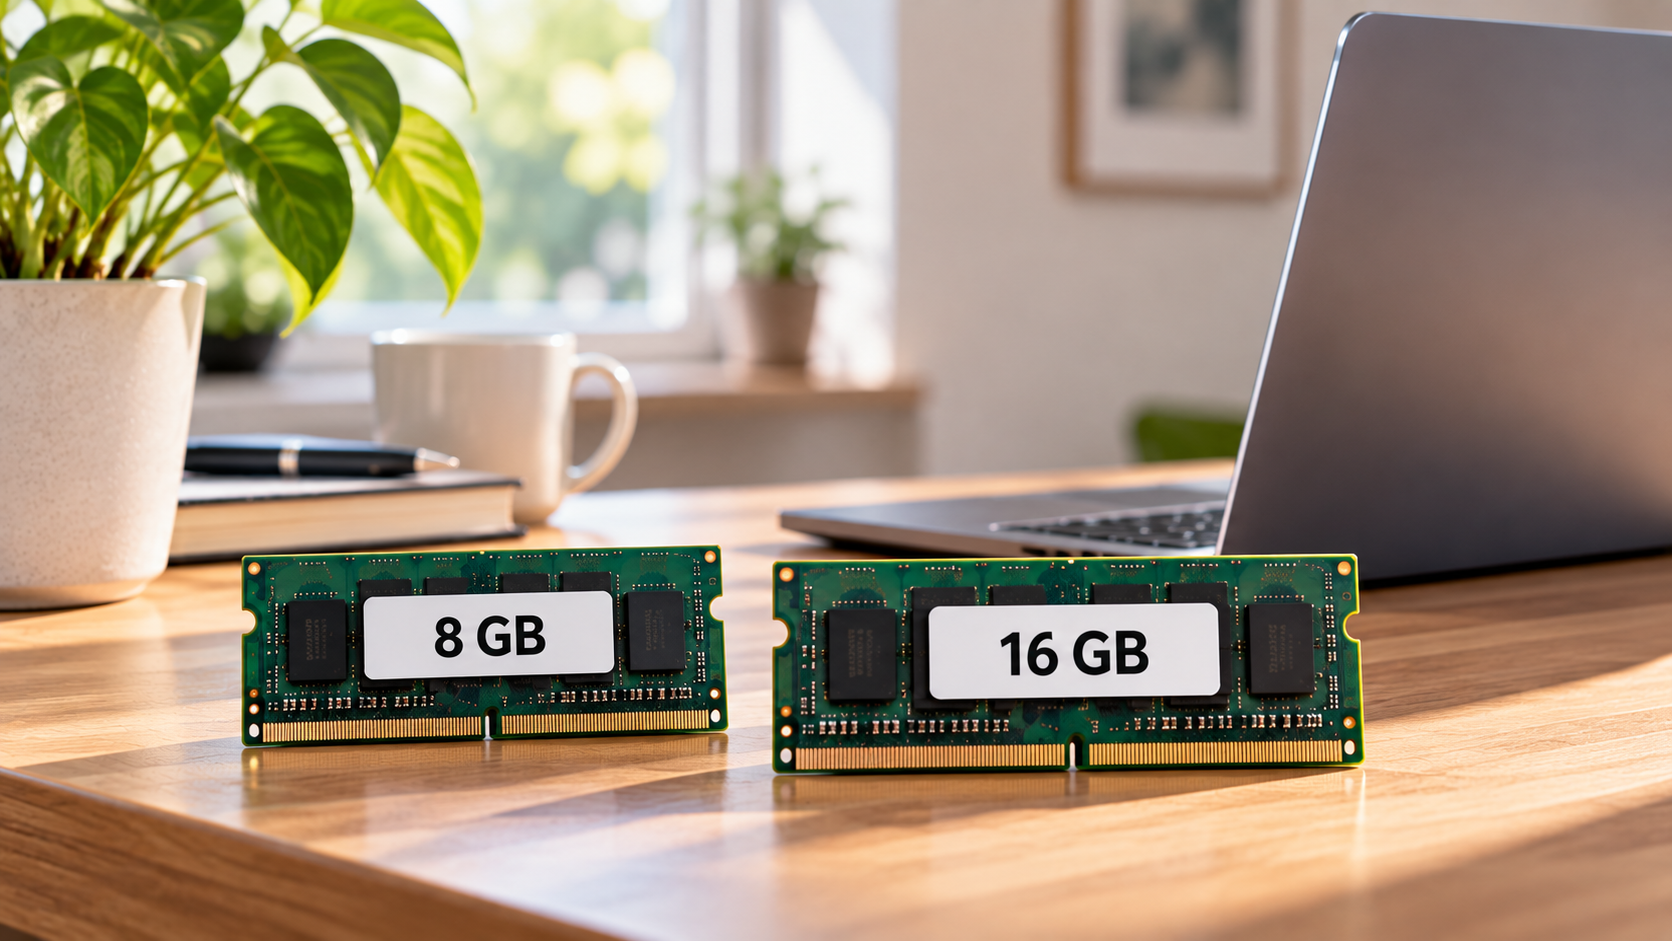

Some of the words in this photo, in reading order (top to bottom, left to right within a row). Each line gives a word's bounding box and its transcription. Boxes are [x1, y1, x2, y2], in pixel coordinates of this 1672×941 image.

[434, 616, 464, 659] 8
[476, 614, 546, 657] GB
[1000, 631, 1059, 677] 16
[1072, 630, 1149, 676] GB
